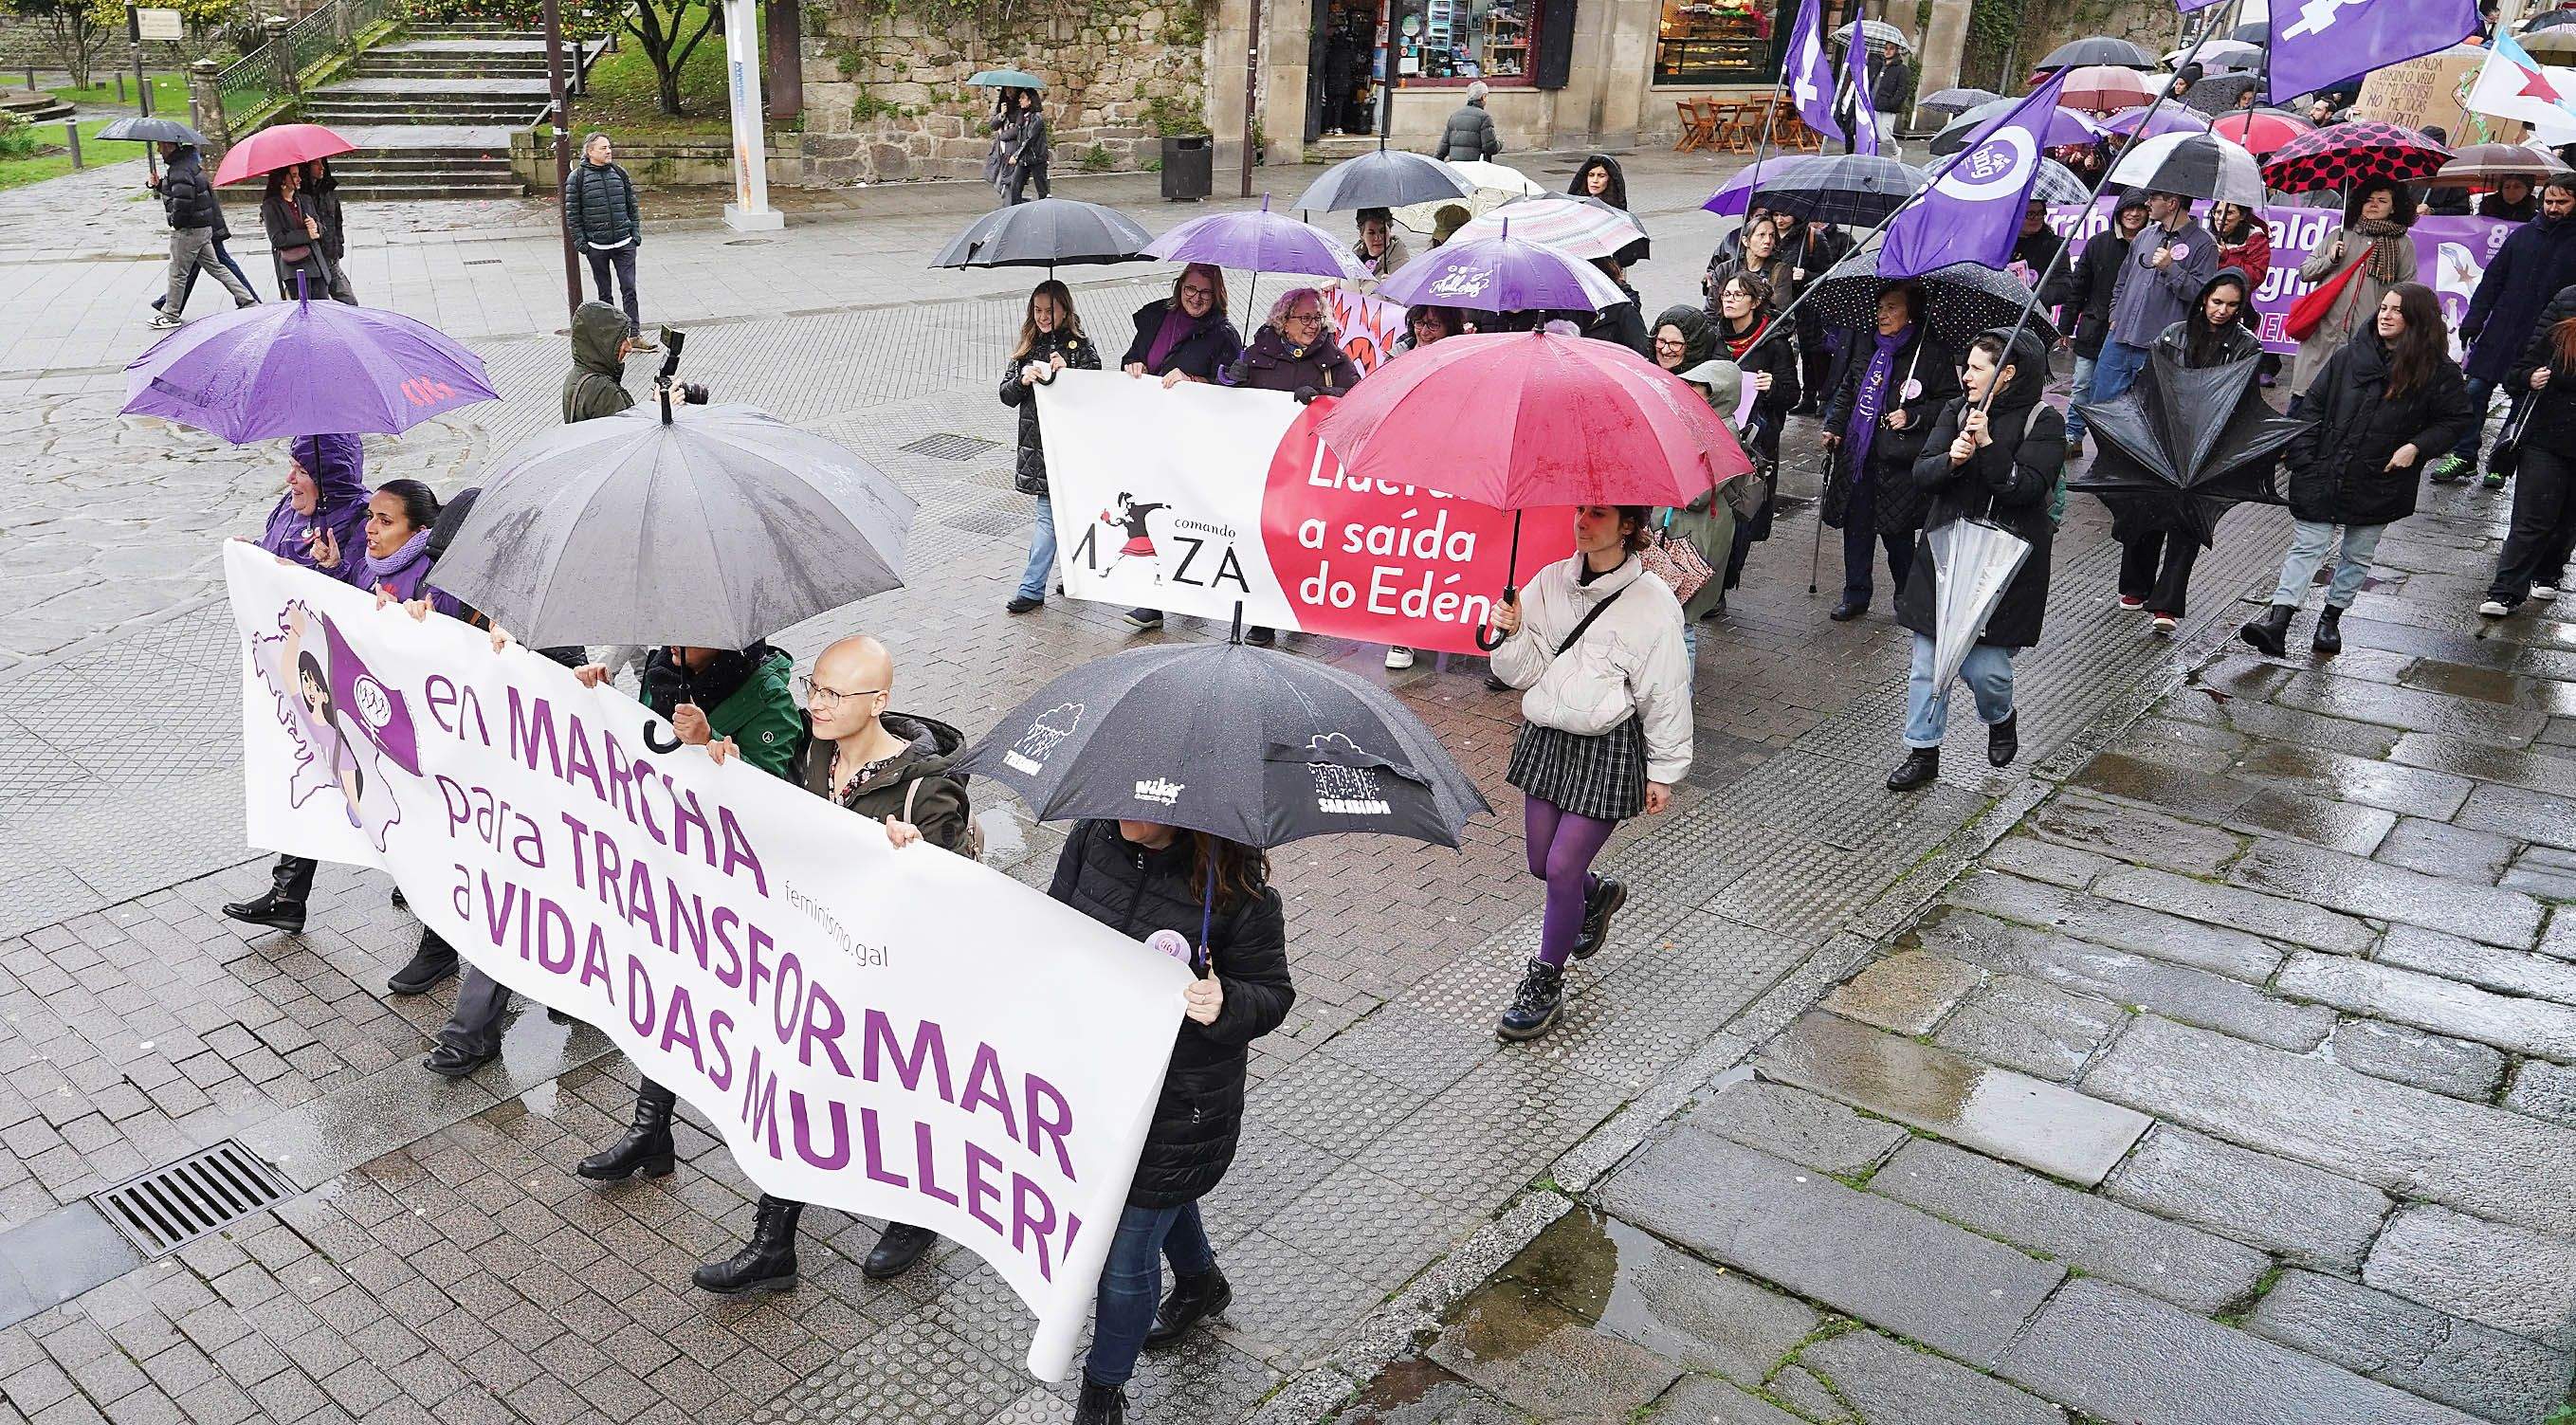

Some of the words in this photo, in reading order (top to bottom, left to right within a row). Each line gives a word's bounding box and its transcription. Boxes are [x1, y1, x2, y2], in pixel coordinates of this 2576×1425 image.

[2366, 93, 2383, 107] NO
[1175, 519, 1236, 539] comando
[1298, 518, 1326, 550] a
[1342, 507, 1476, 562] saída
[1299, 559, 1357, 609] do
[1367, 565, 1491, 626] Edén
[425, 674, 491, 747] en
[507, 685, 770, 900] MARCHA
[785, 880, 888, 968] feminismo.gal
[434, 775, 546, 870] para
[561, 811, 1078, 1184] TRANSFORMAR
[453, 863, 471, 921] a
[481, 871, 614, 1006] VIDA
[628, 955, 736, 1093] DAS
